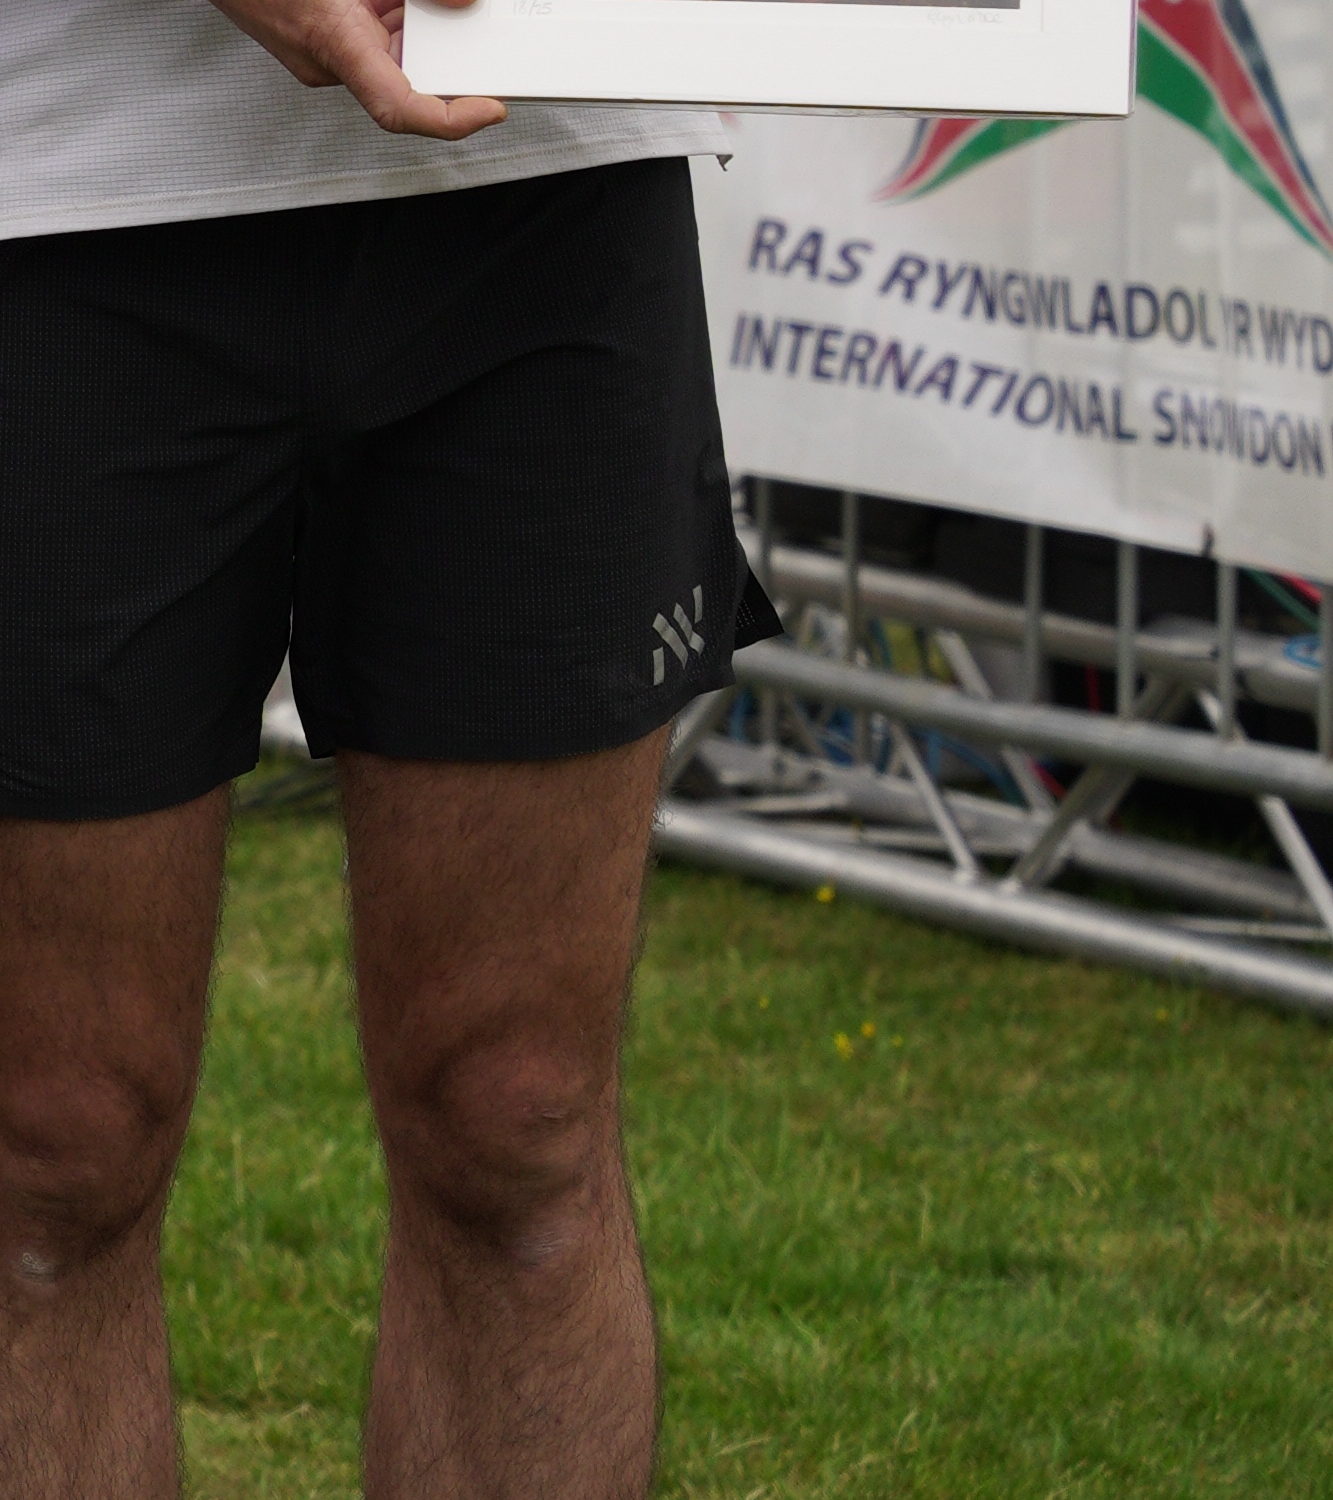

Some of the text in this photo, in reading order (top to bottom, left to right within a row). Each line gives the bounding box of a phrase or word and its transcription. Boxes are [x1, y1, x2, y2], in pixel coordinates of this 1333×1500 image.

[747, 216, 875, 287] RAS
[878, 252, 1217, 349] RYNGWLADOL
[730, 311, 1327, 481] INTERNATIONAL SNOWDON
